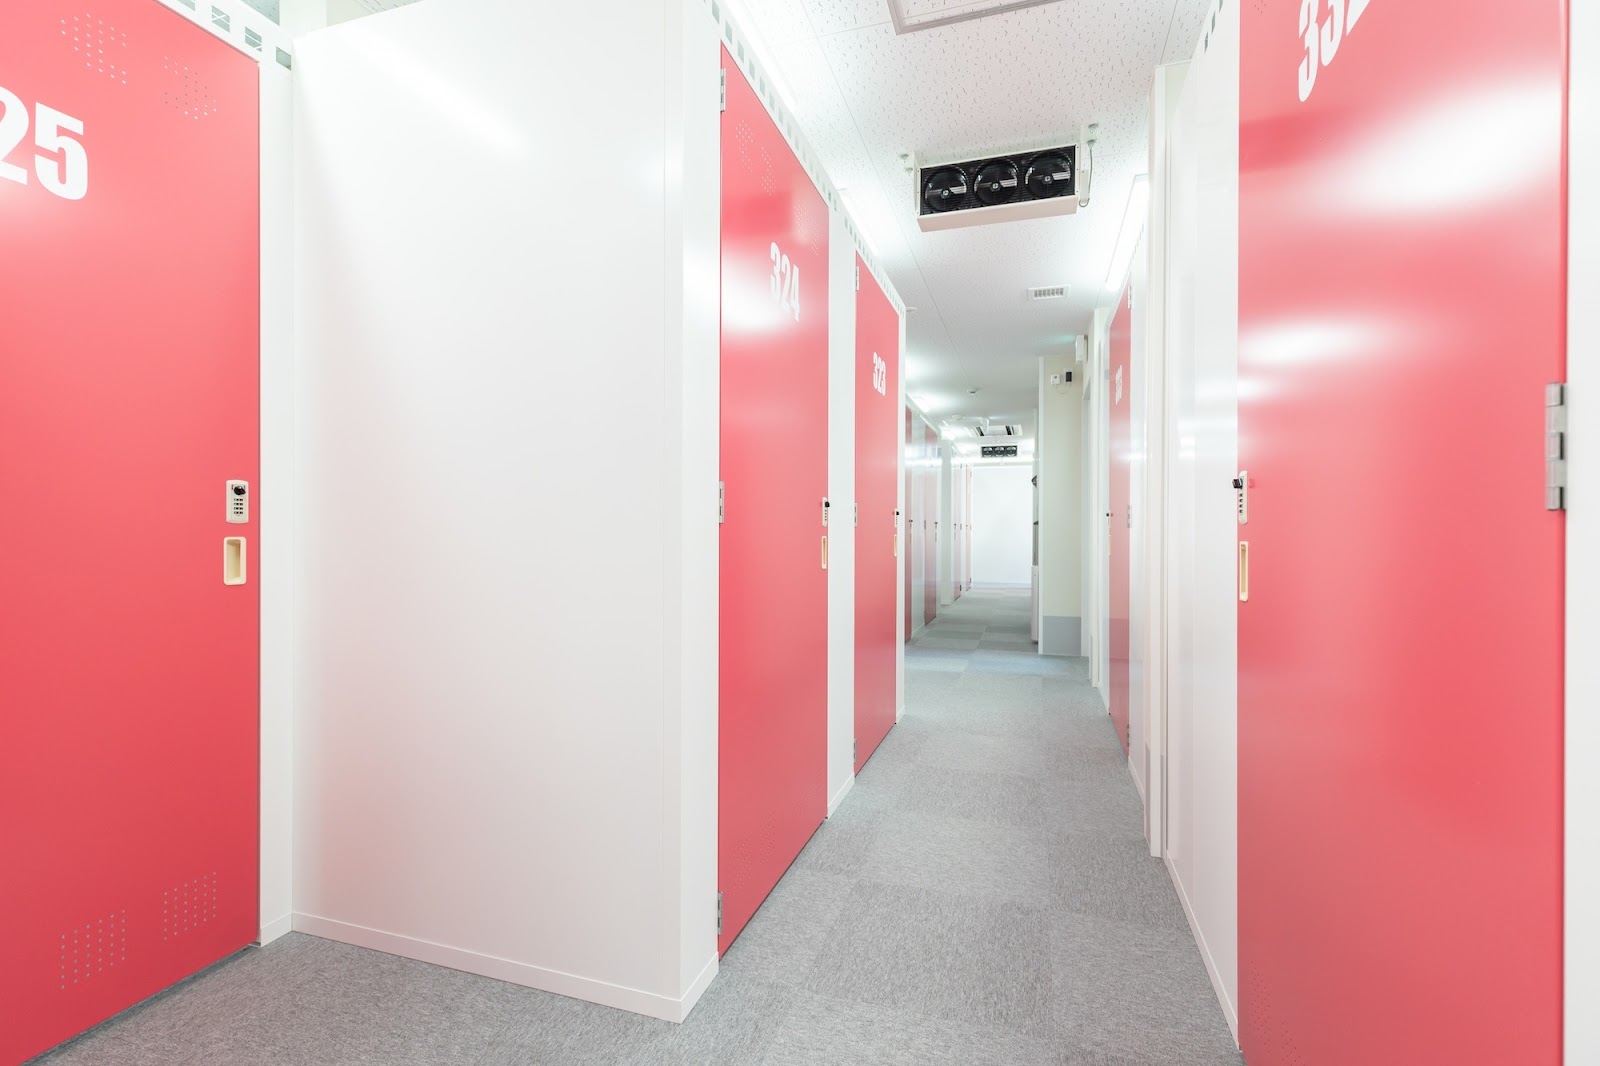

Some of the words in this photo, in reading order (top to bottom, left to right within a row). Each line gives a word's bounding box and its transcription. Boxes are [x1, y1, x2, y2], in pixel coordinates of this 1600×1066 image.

[1298, 0, 1371, 102] 33
[770, 241, 800, 322] 324
[873, 351, 886, 397] 323
